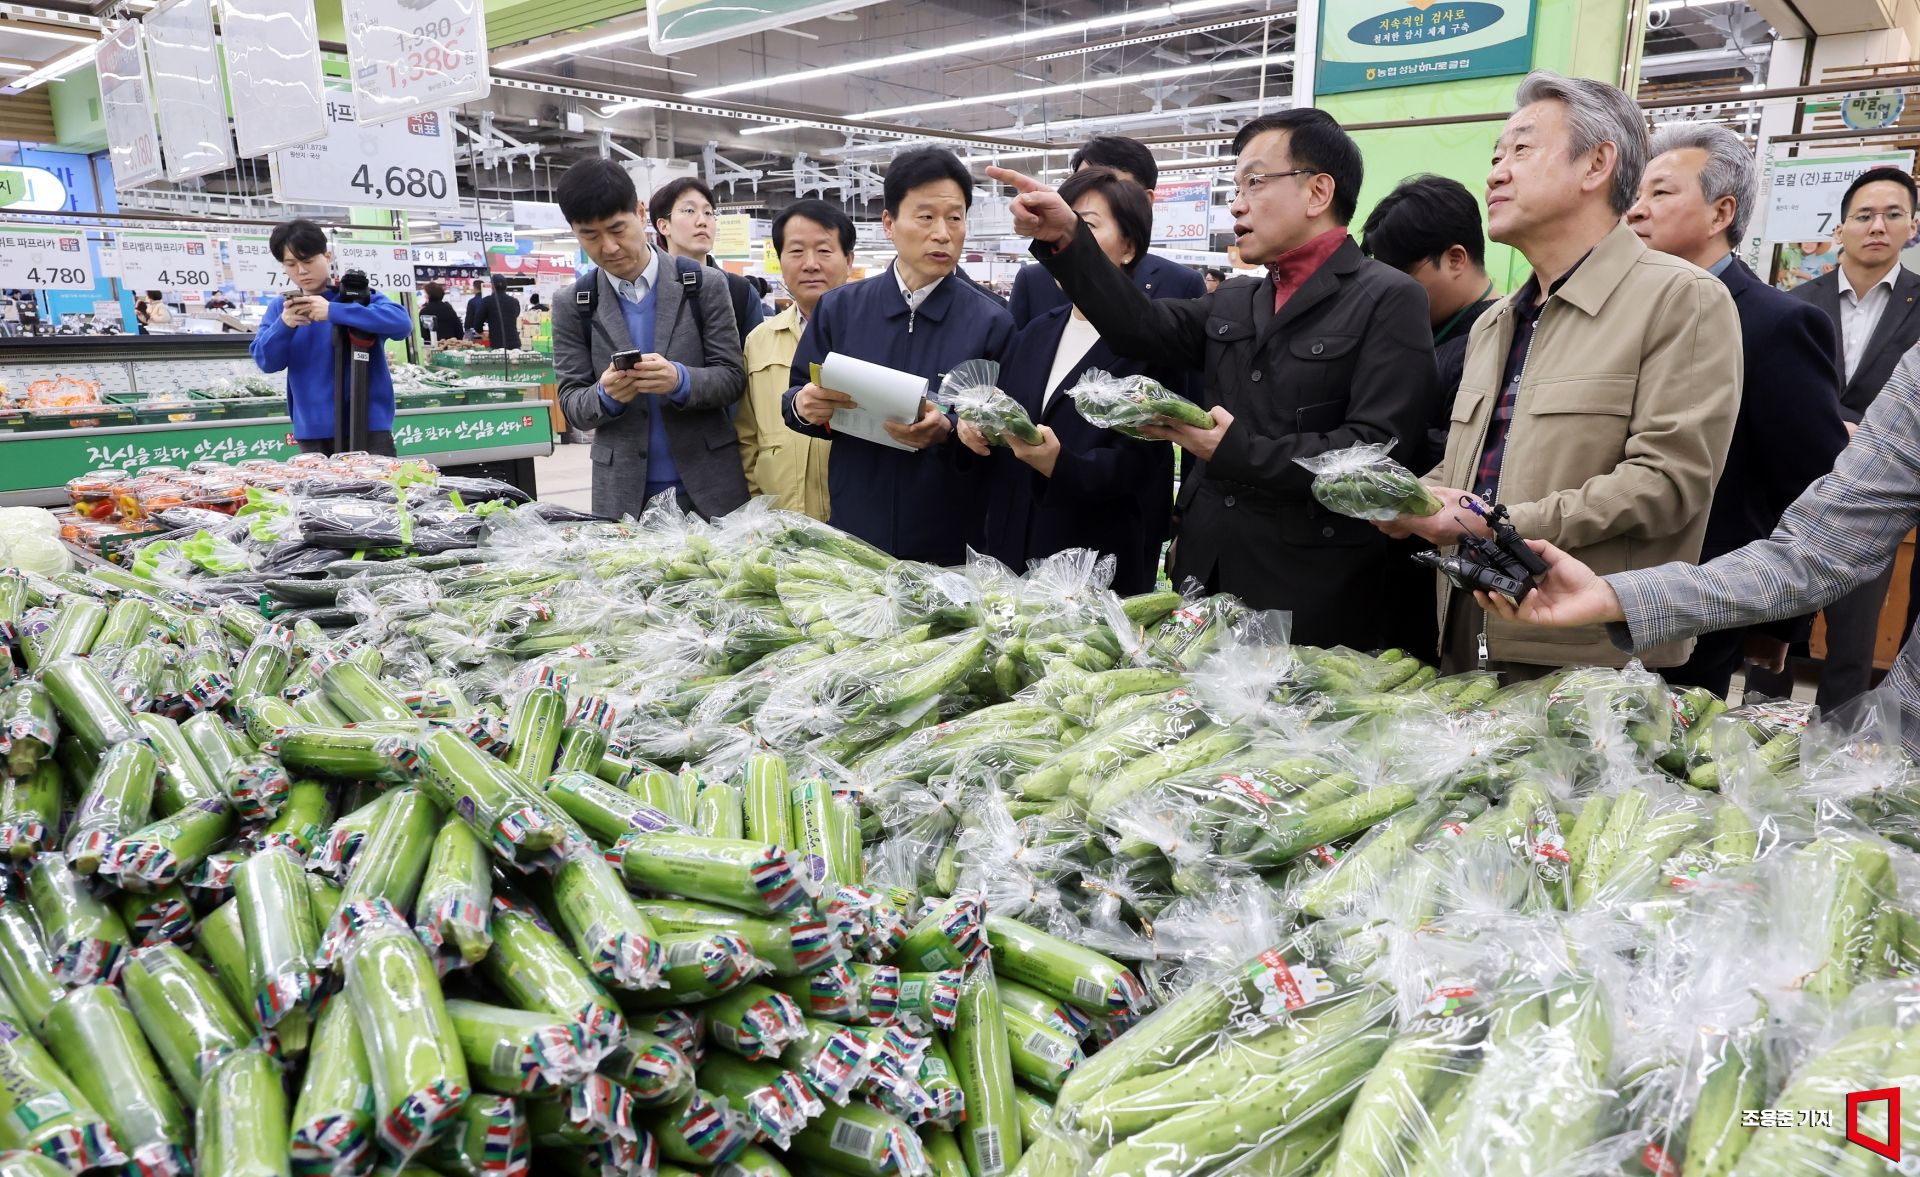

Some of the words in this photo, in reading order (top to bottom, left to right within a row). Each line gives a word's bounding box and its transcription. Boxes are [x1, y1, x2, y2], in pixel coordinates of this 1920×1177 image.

[1379, 14, 1425, 30] 지속적인
[1431, 9, 1466, 22] 검사로
[1373, 32, 1400, 44] 철저한
[1404, 29, 1422, 40] 감시
[1427, 26, 1446, 36] 체계
[1451, 22, 1470, 33] 구축
[1377, 66, 1397, 78] 농협
[350, 164, 447, 199] 4,680
[1774, 174, 1797, 187] 로컬
[453, 230, 513, 243] 풍기인삼농협
[1166, 224, 1205, 238] 2,380
[18, 238, 55, 249] 파프리카
[365, 249, 378, 258] 고추
[27, 267, 86, 285] 4,780
[158, 270, 210, 286] 4,580
[369, 273, 411, 288] 5,180
[425, 426, 452, 441] 판다
[455, 419, 494, 440] 안심을
[496, 421, 522, 436] 산다
[86, 444, 151, 469] 진심을
[153, 446, 190, 462] 판다
[194, 437, 248, 461] 안심을
[251, 439, 284, 455] 산다
